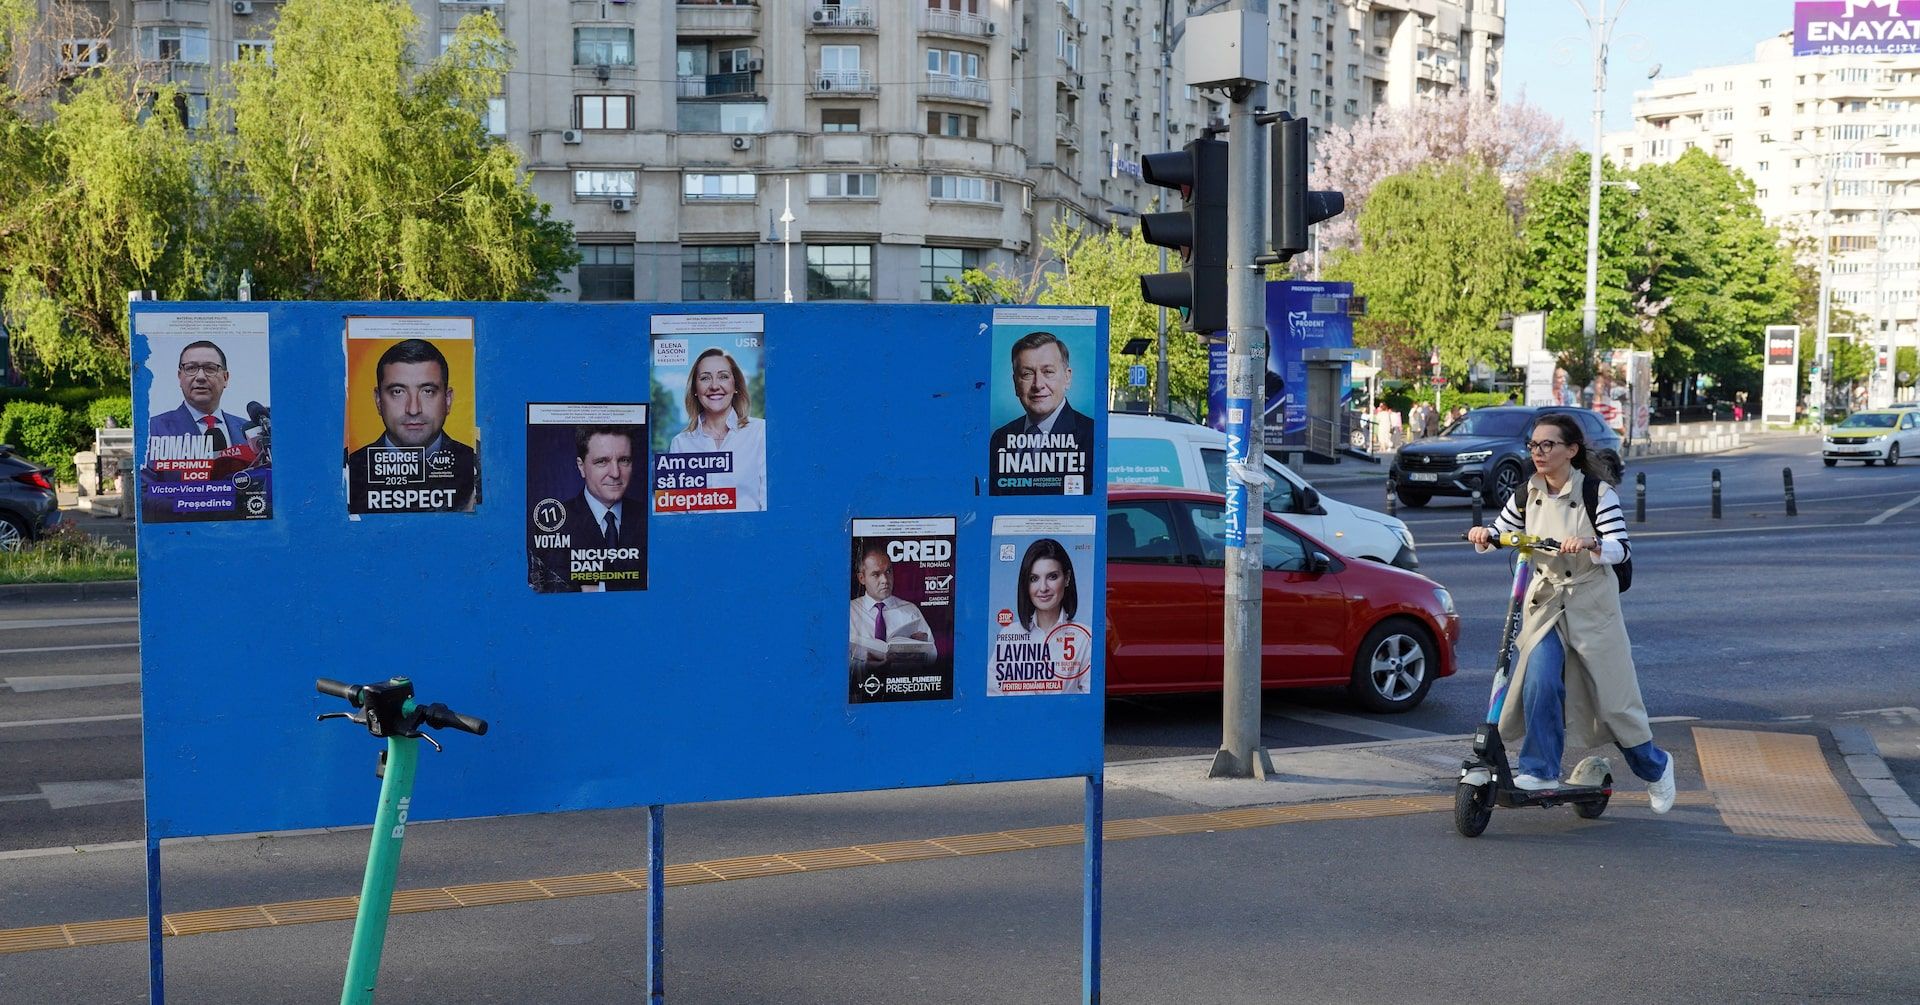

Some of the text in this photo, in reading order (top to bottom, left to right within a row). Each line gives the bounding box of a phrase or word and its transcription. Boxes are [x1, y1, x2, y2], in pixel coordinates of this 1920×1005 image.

[1821, 44, 1918, 54] MEDICAL CITY
[1296, 320, 1325, 328] PRODENT
[1138, 368, 1145, 379] P
[150, 432, 214, 460] ROMÂNIA
[1006, 431, 1079, 450] ROMÂNIA,
[374, 452, 418, 464] GEORGE
[432, 456, 451, 465] AUR
[657, 453, 730, 471] Am curaj
[997, 448, 1086, 473] ÎNAINTE!
[156, 461, 212, 470] PE PRIMUL
[374, 464, 419, 476] SIMION
[183, 472, 208, 480] LOC!
[385, 477, 408, 485] 2025
[657, 472, 705, 489] să fac
[152, 484, 232, 494] Victor-Viorel Ponta
[997, 478, 1032, 488] CRIN
[177, 500, 232, 510] Președinte
[368, 489, 456, 509] RESPECT
[657, 492, 734, 510] dreptate.
[541, 507, 558, 523] 11
[534, 533, 571, 549] VOTĂM
[570, 548, 640, 564] NICUȘOR
[887, 540, 951, 563] CRED
[570, 561, 604, 573] DAN
[570, 571, 640, 583] PREȘEDINTE
[925, 581, 937, 591] 10
[996, 643, 1051, 662] LAVINIA
[1063, 637, 1075, 661] 5
[886, 682, 942, 694] PREȘEDINTE
[1003, 682, 1022, 691] PENTRU
[1022, 681, 1045, 690] ROMÂNIA
[391, 796, 411, 839] Bolt
